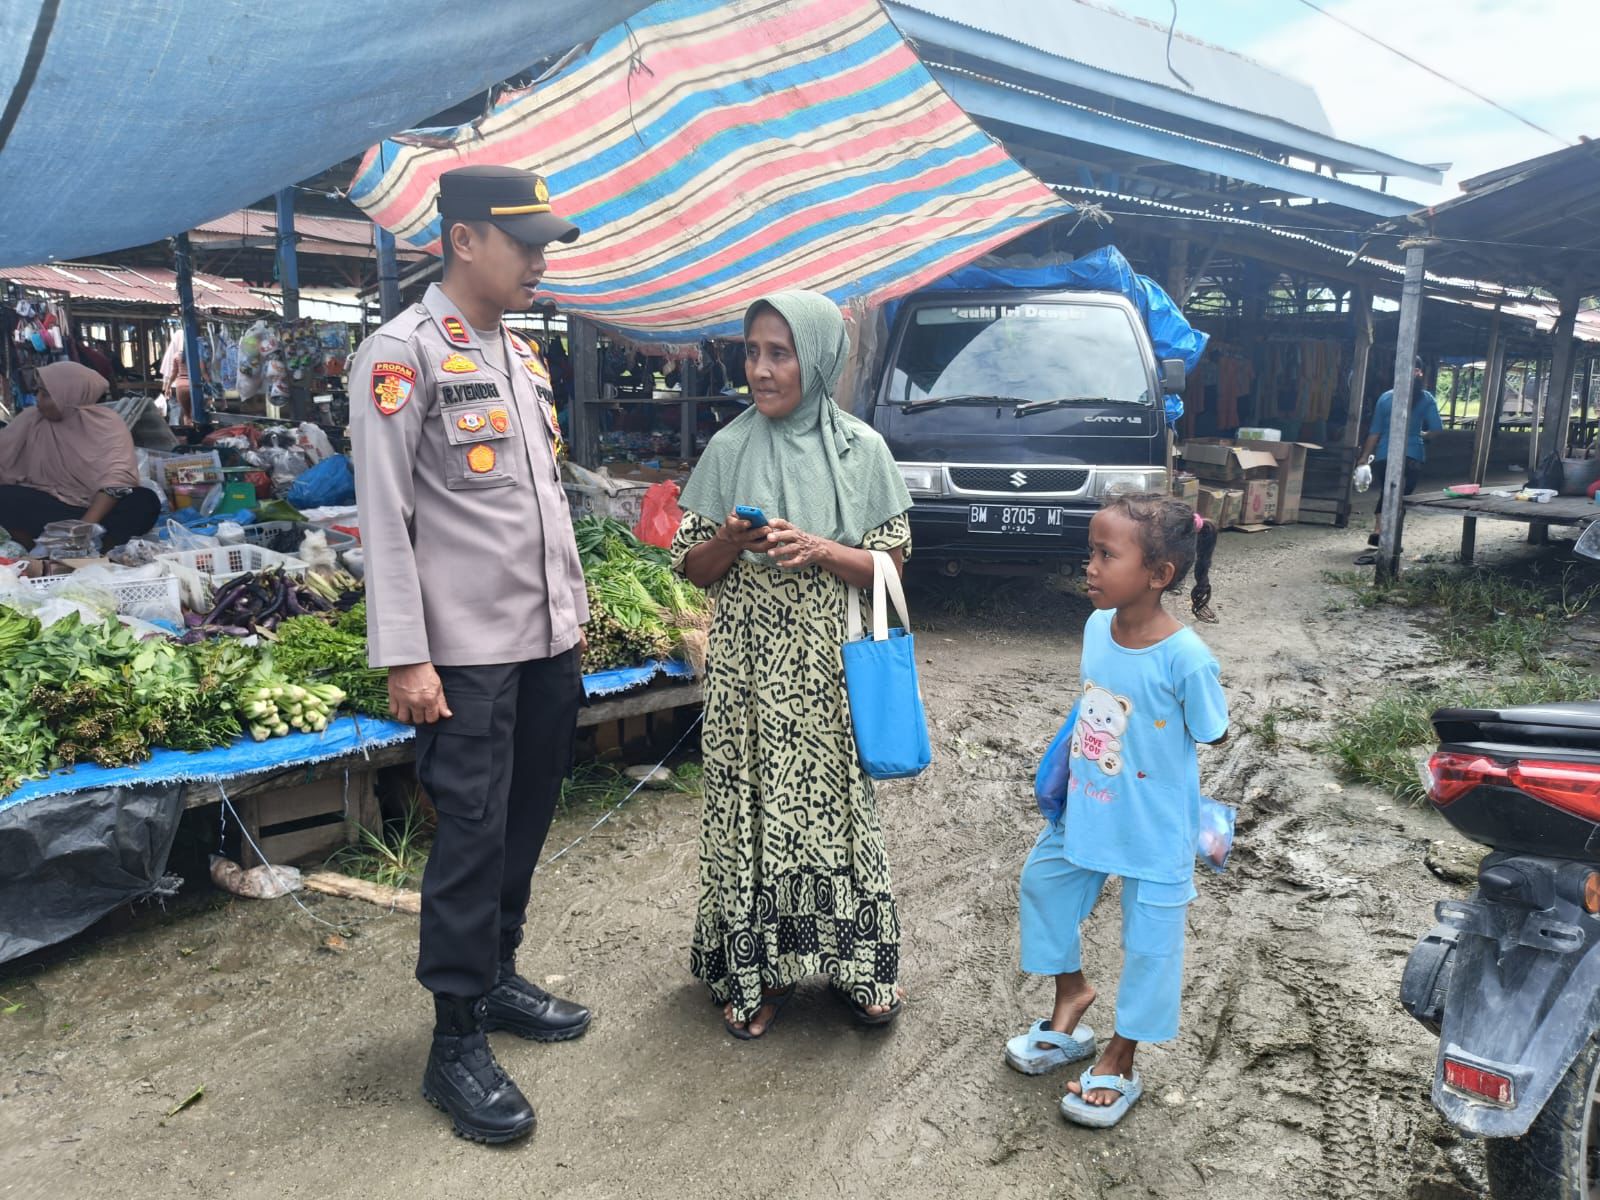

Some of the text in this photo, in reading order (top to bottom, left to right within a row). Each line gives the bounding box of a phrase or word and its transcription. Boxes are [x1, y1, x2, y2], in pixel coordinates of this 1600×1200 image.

[1001, 305, 1020, 319] Iri
[376, 363, 413, 378] PROPAM
[971, 506, 1062, 525] BM 8705 MI
[1084, 732, 1103, 748] LOVE
[1084, 741, 1101, 755] YOU
